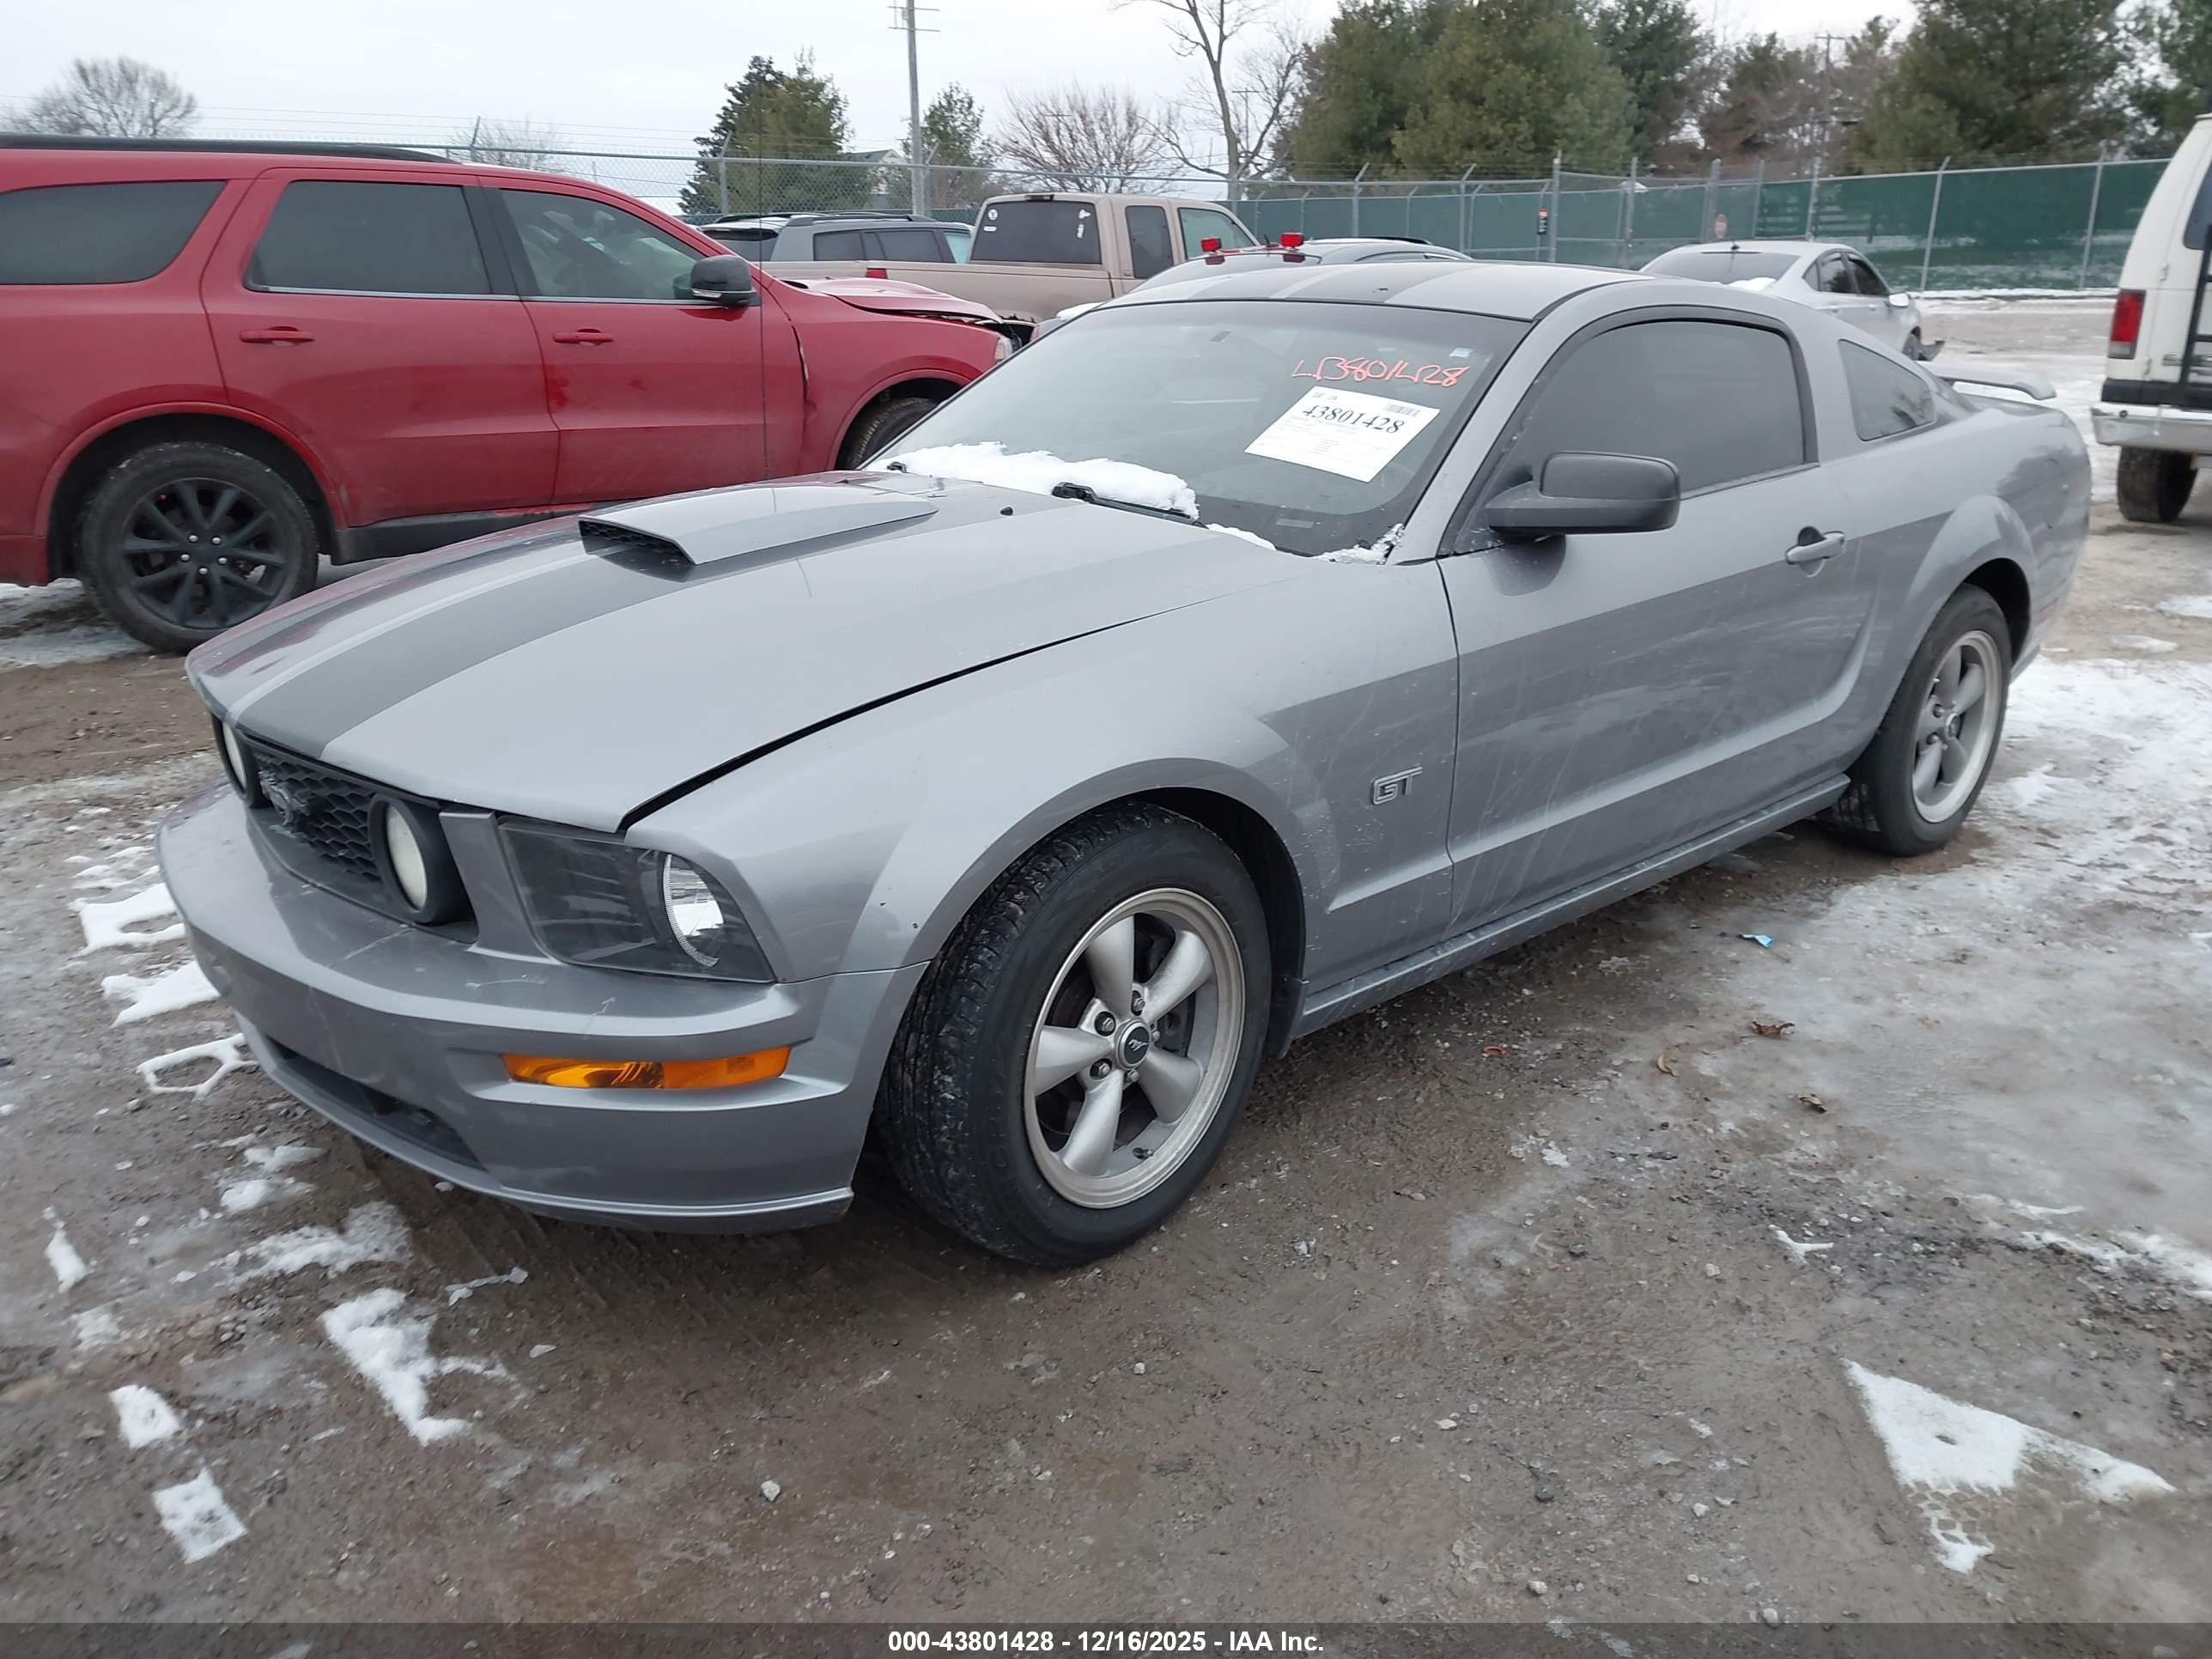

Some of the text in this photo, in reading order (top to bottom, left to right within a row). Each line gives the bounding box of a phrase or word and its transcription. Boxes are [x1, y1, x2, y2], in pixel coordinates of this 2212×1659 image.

[1291, 356, 1470, 386] 43801428
[1302, 404, 1405, 434] 43801428
[1372, 766, 1423, 805] GT
